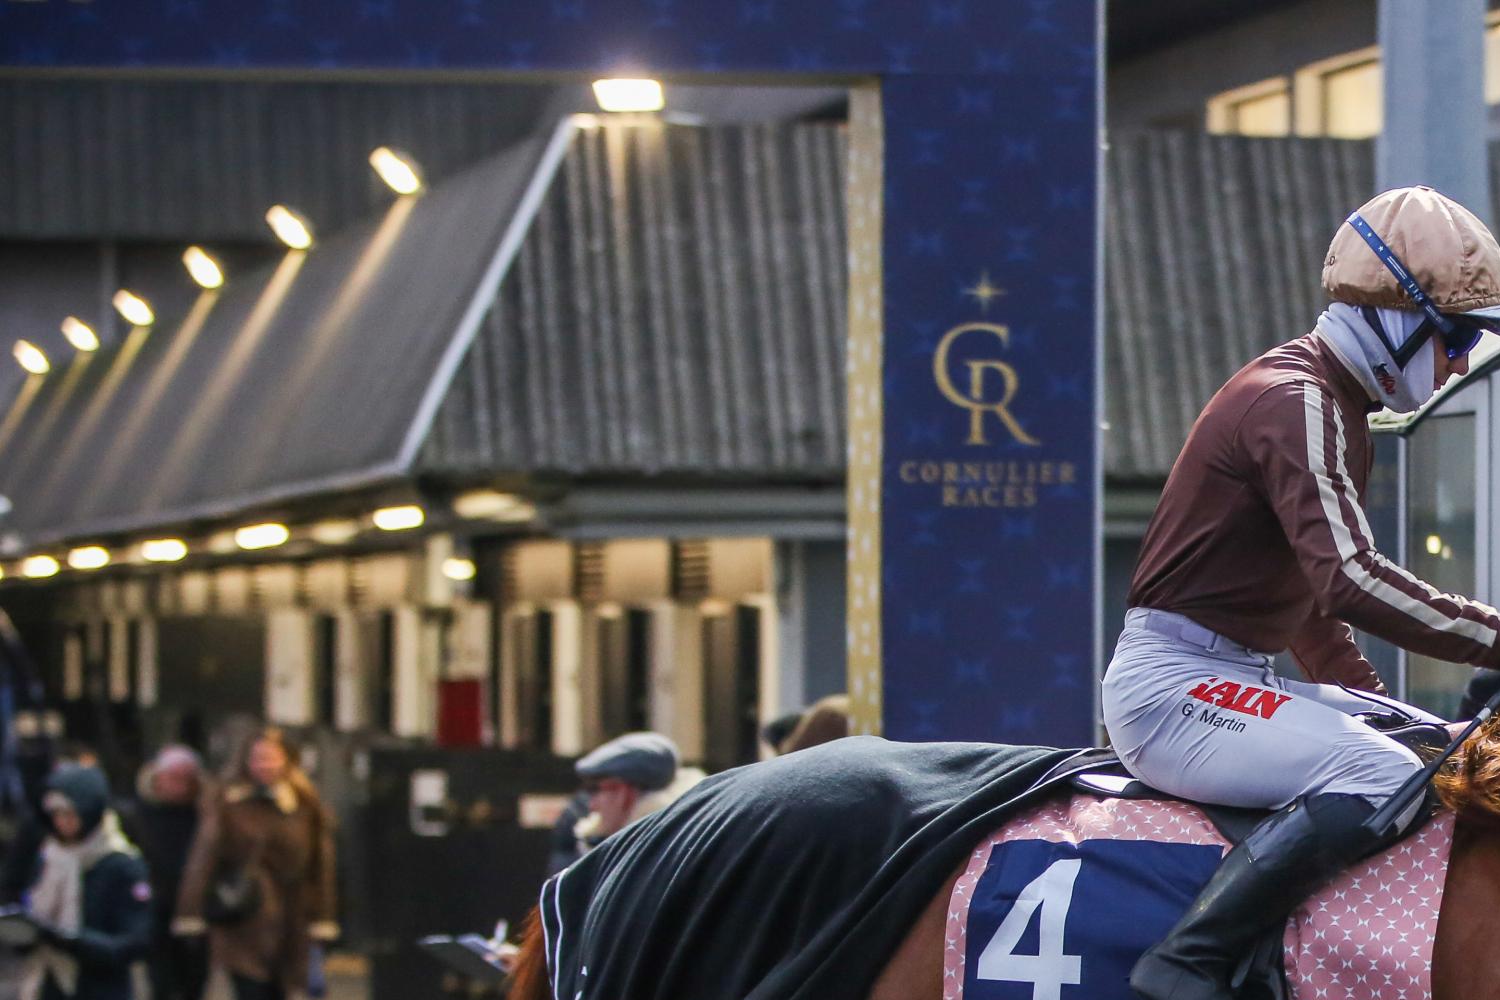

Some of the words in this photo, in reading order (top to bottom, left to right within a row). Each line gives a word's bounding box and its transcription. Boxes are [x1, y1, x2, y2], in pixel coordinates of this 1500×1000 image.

[899, 461, 1076, 484] CORNULIER
[942, 485, 1039, 508] RACES
[1181, 702, 1194, 719] G.
[1200, 709, 1247, 734] Martin
